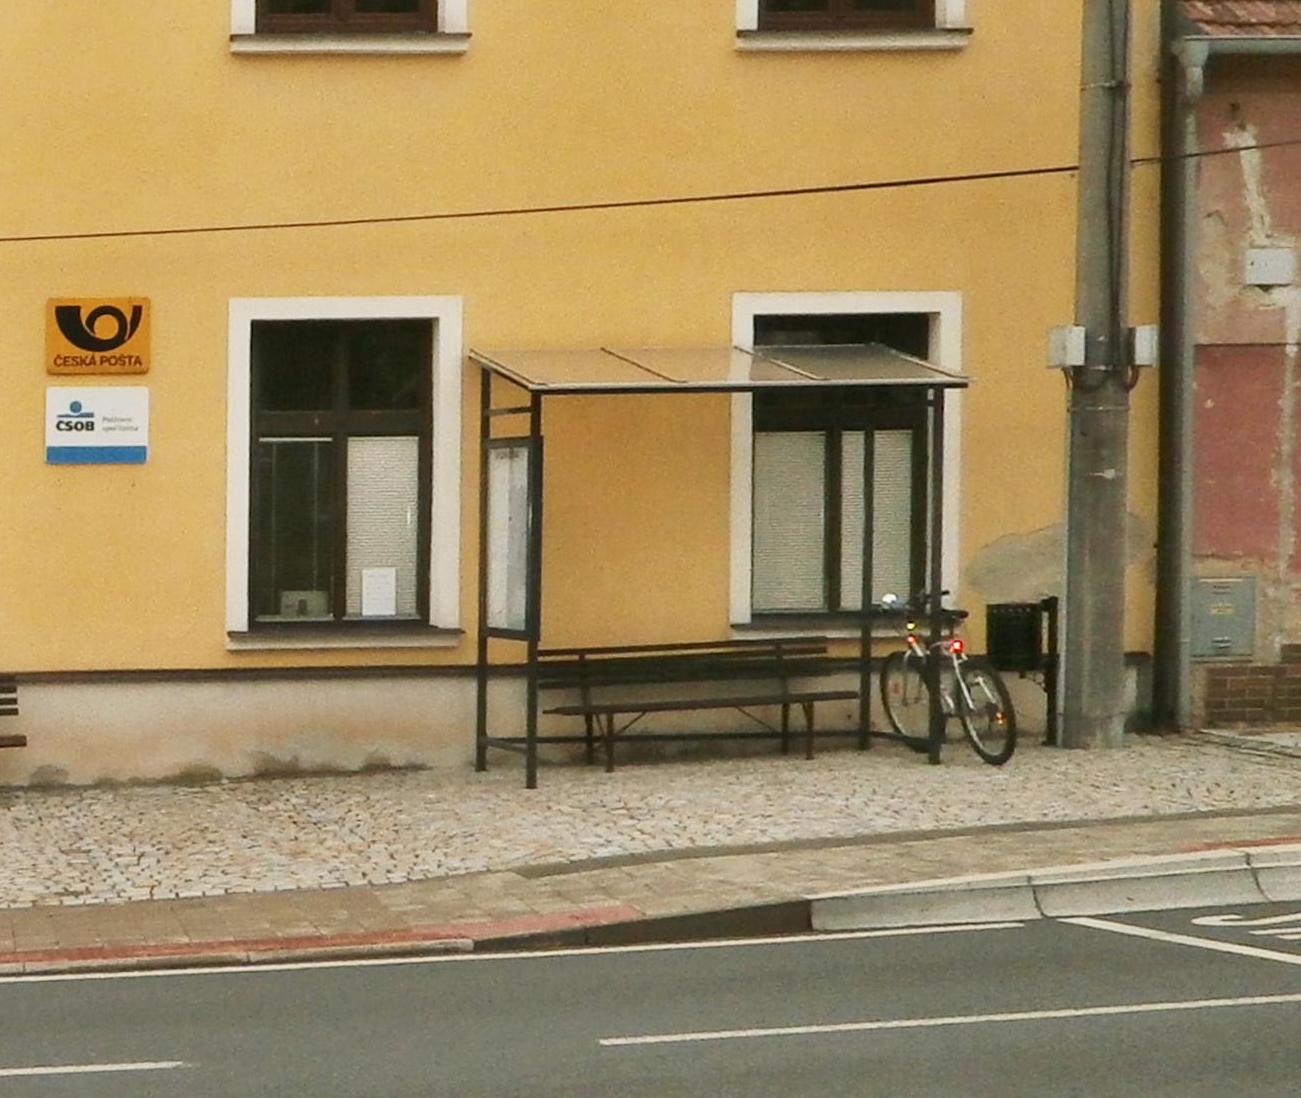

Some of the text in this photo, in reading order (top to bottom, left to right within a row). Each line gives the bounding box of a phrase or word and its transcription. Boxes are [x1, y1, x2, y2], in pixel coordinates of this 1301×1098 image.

[53, 353, 142, 367] ČESKÁ POŠTA
[56, 420, 95, 431] ČSOB
